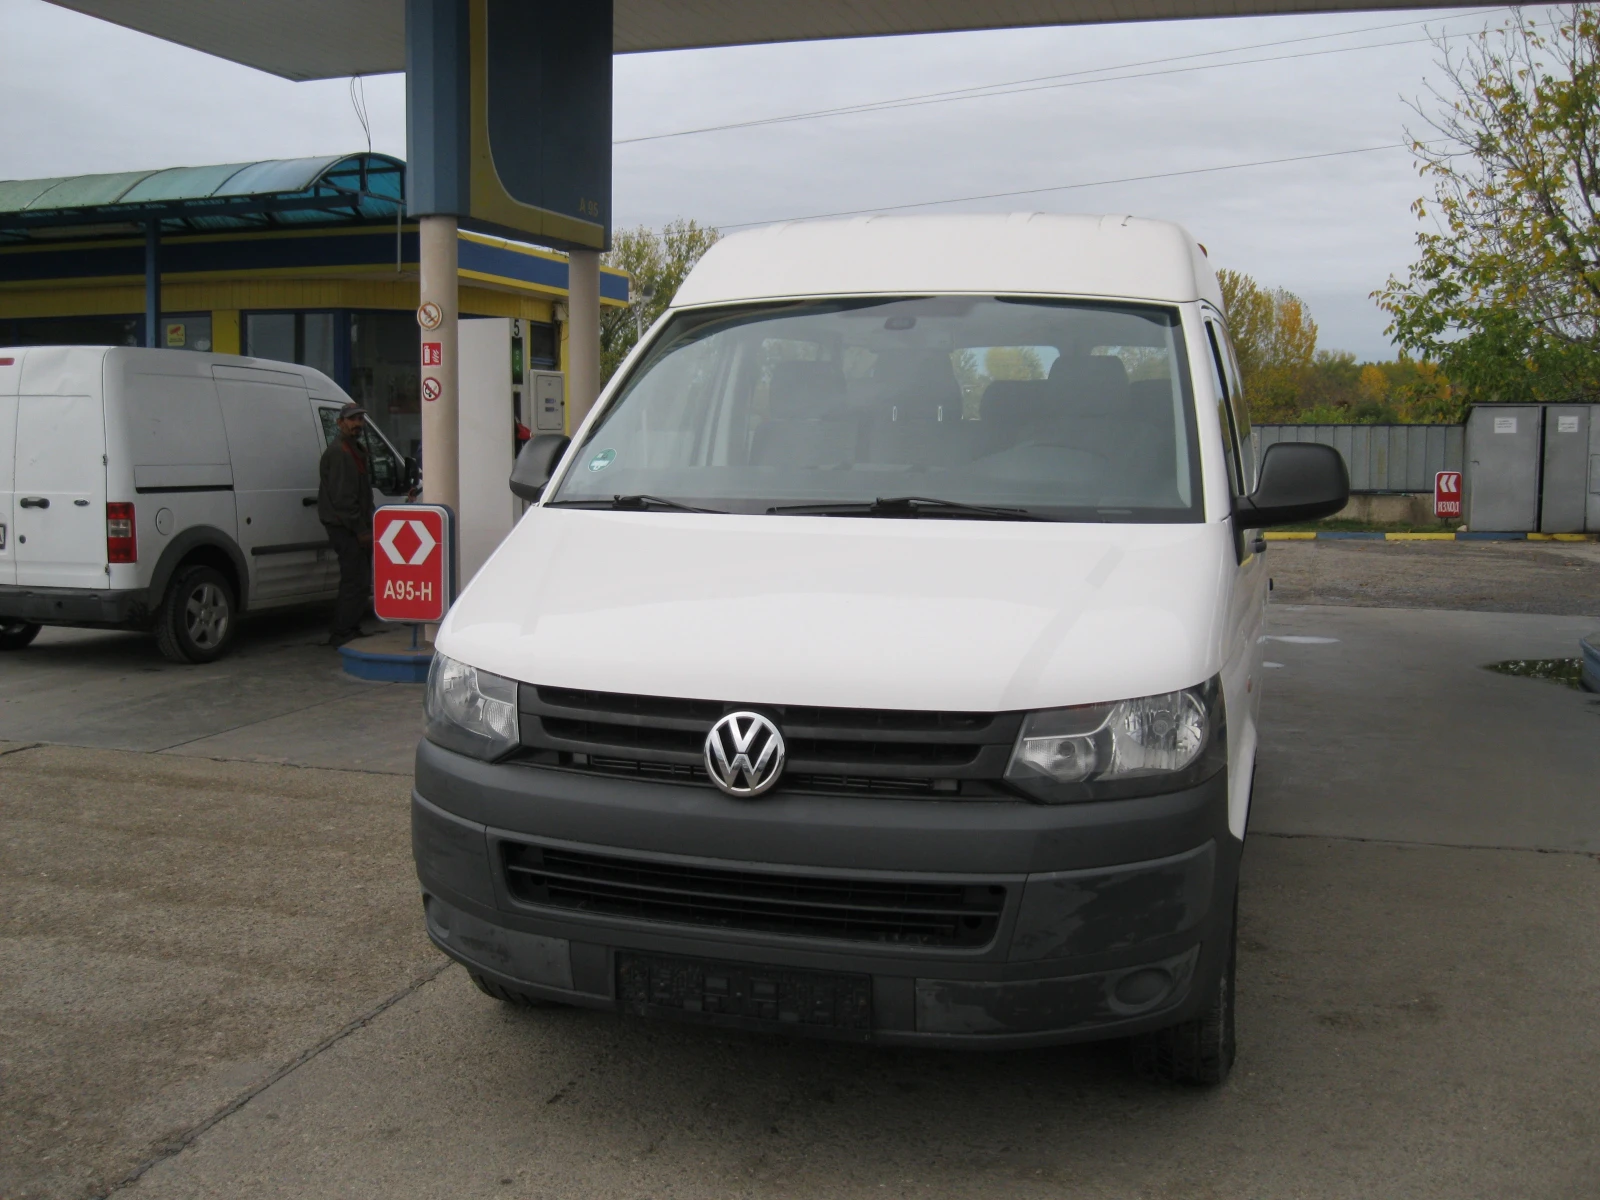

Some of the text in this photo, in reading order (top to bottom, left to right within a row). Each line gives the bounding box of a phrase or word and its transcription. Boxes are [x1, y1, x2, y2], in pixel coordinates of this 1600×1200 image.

[514, 319, 520, 336] 5
[1437, 501, 1460, 514] ИЗХОД
[704, 711, 785, 797] VW
